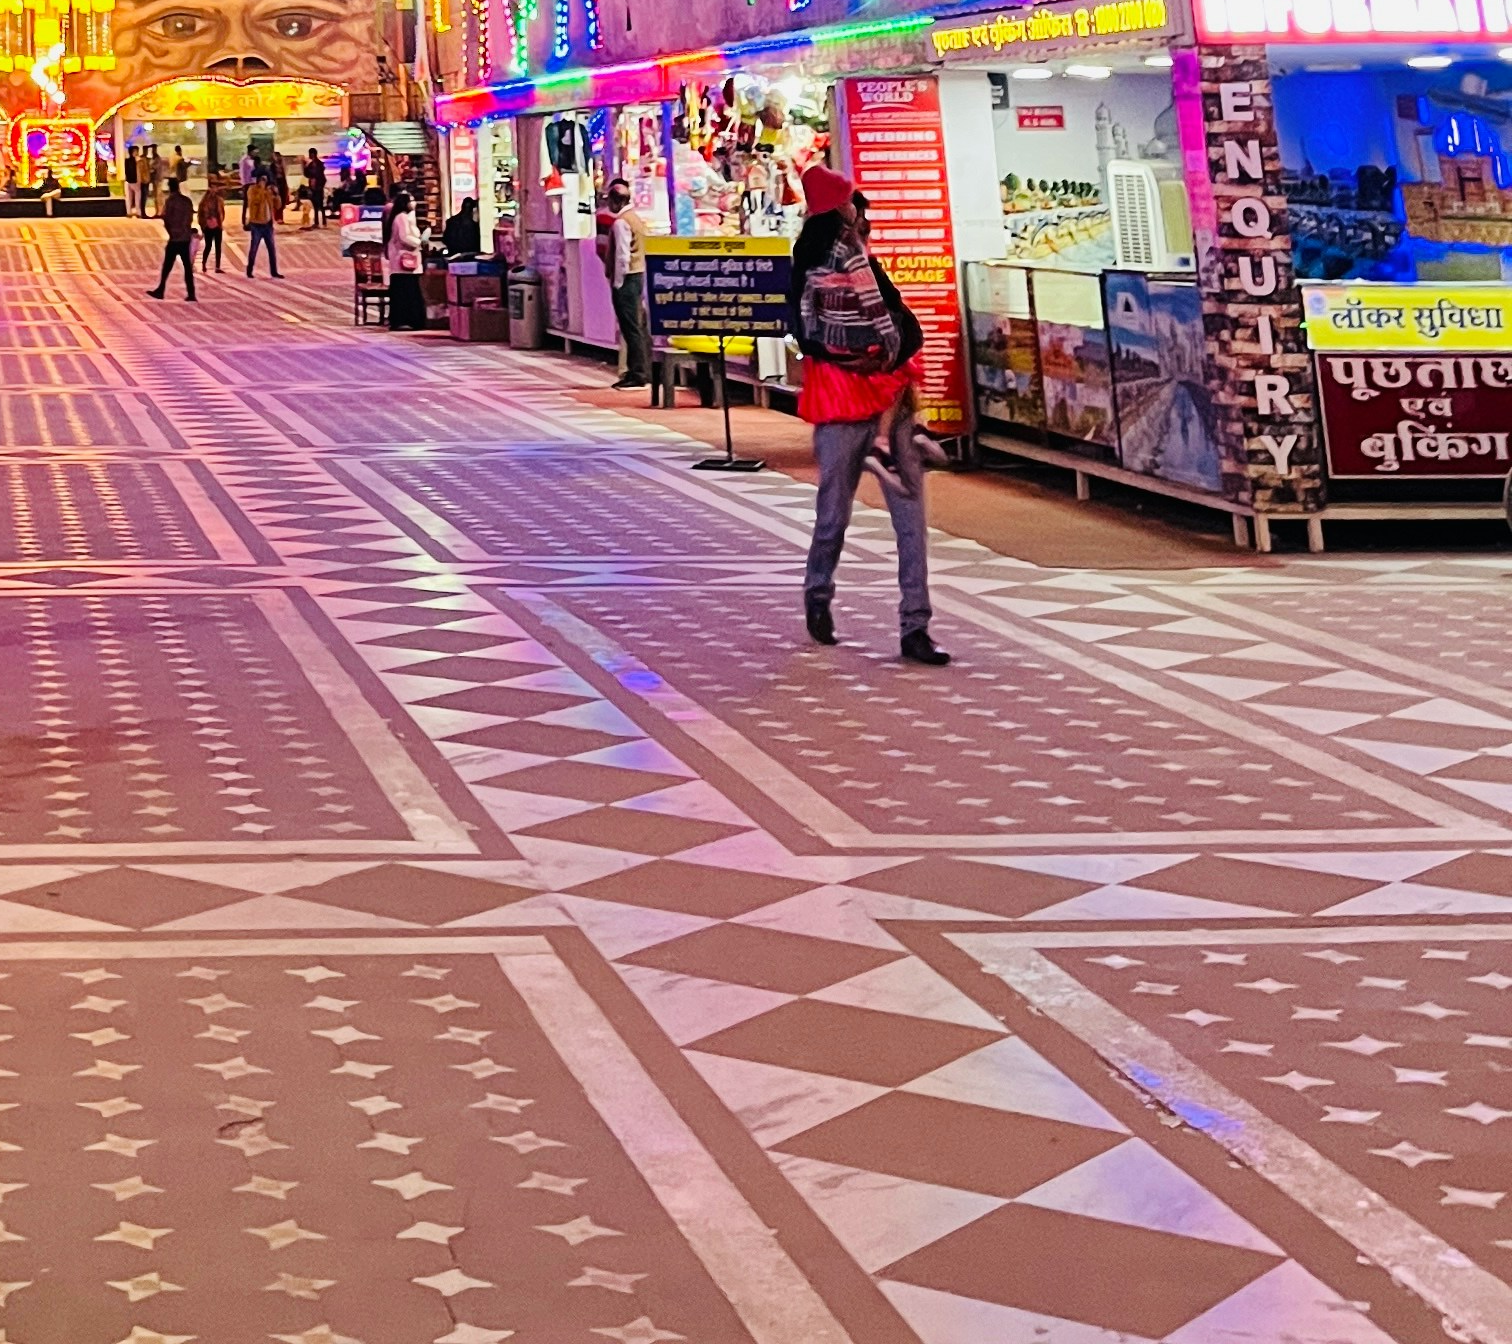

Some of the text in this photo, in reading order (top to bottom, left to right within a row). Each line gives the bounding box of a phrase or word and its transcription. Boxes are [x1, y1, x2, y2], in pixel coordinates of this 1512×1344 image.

[857, 79, 928, 93] PEOPLE'S
[860, 92, 914, 103] WORLD
[857, 130, 937, 143] WEDDING
[896, 255, 954, 269] OUTING
[886, 269, 947, 283] ACKAGE
[1220, 82, 1297, 476] ENQUIRY
[1330, 298, 1503, 338] लॉकर सुविधा
[1399, 391, 1453, 419] एवं
[1360, 420, 1510, 472] बुकिंग
